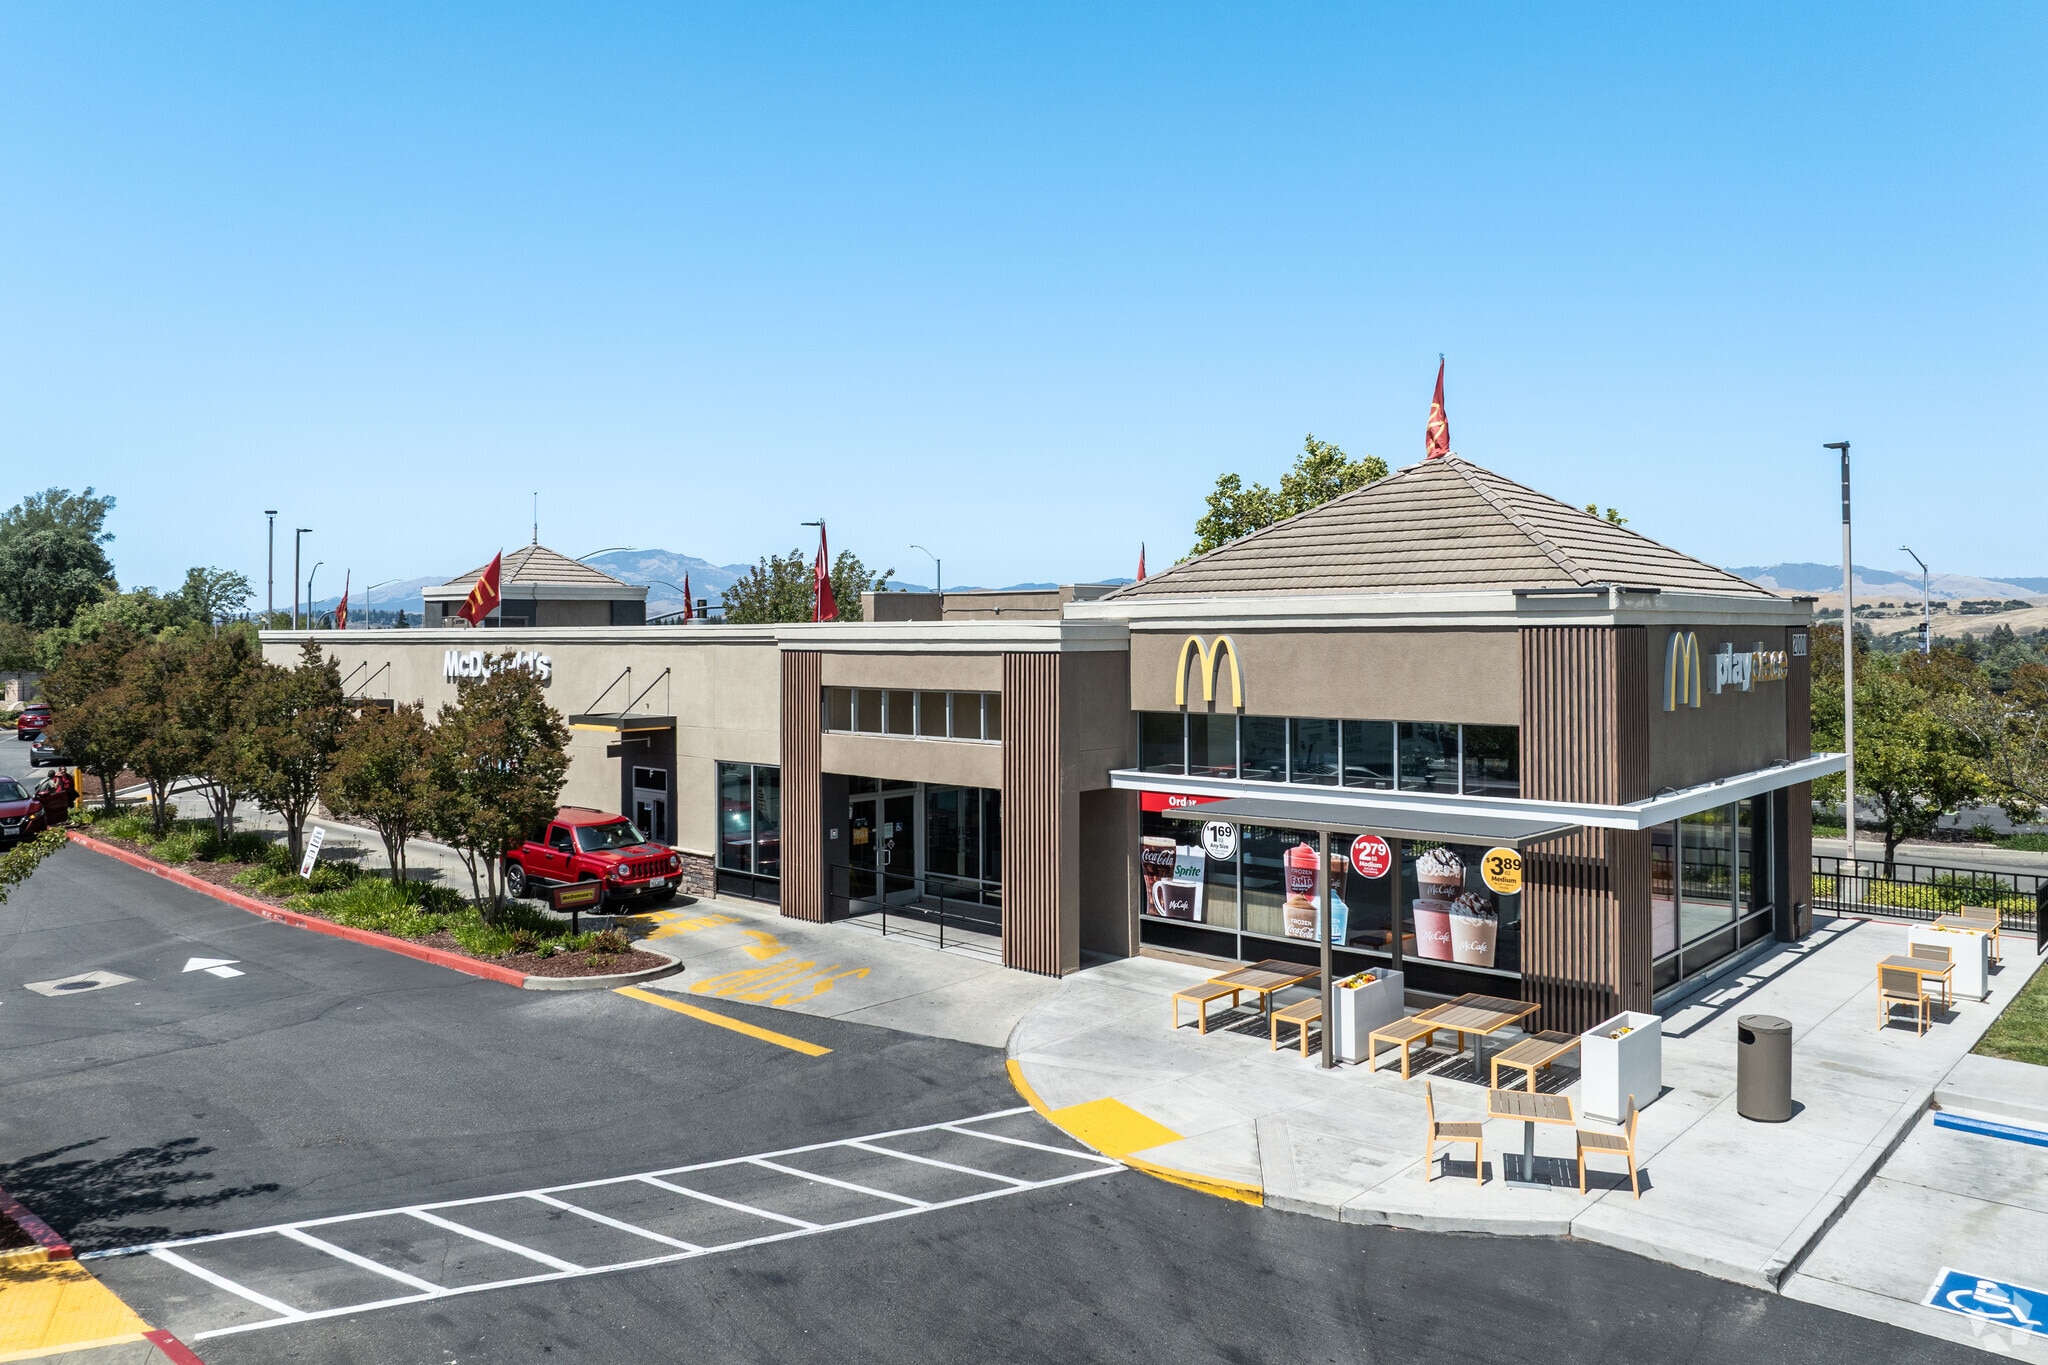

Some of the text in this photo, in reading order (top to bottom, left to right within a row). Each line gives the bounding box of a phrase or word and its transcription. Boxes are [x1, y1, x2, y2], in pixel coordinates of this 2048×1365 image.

[1359, 861, 1383, 869] Medium
[1174, 864, 1201, 877] Sprite
[1290, 868, 1313, 876] FROZEN
[1491, 876, 1517, 884] Medium
[1290, 917, 1313, 927] FROZEN
[690, 958, 871, 1006] STOP
